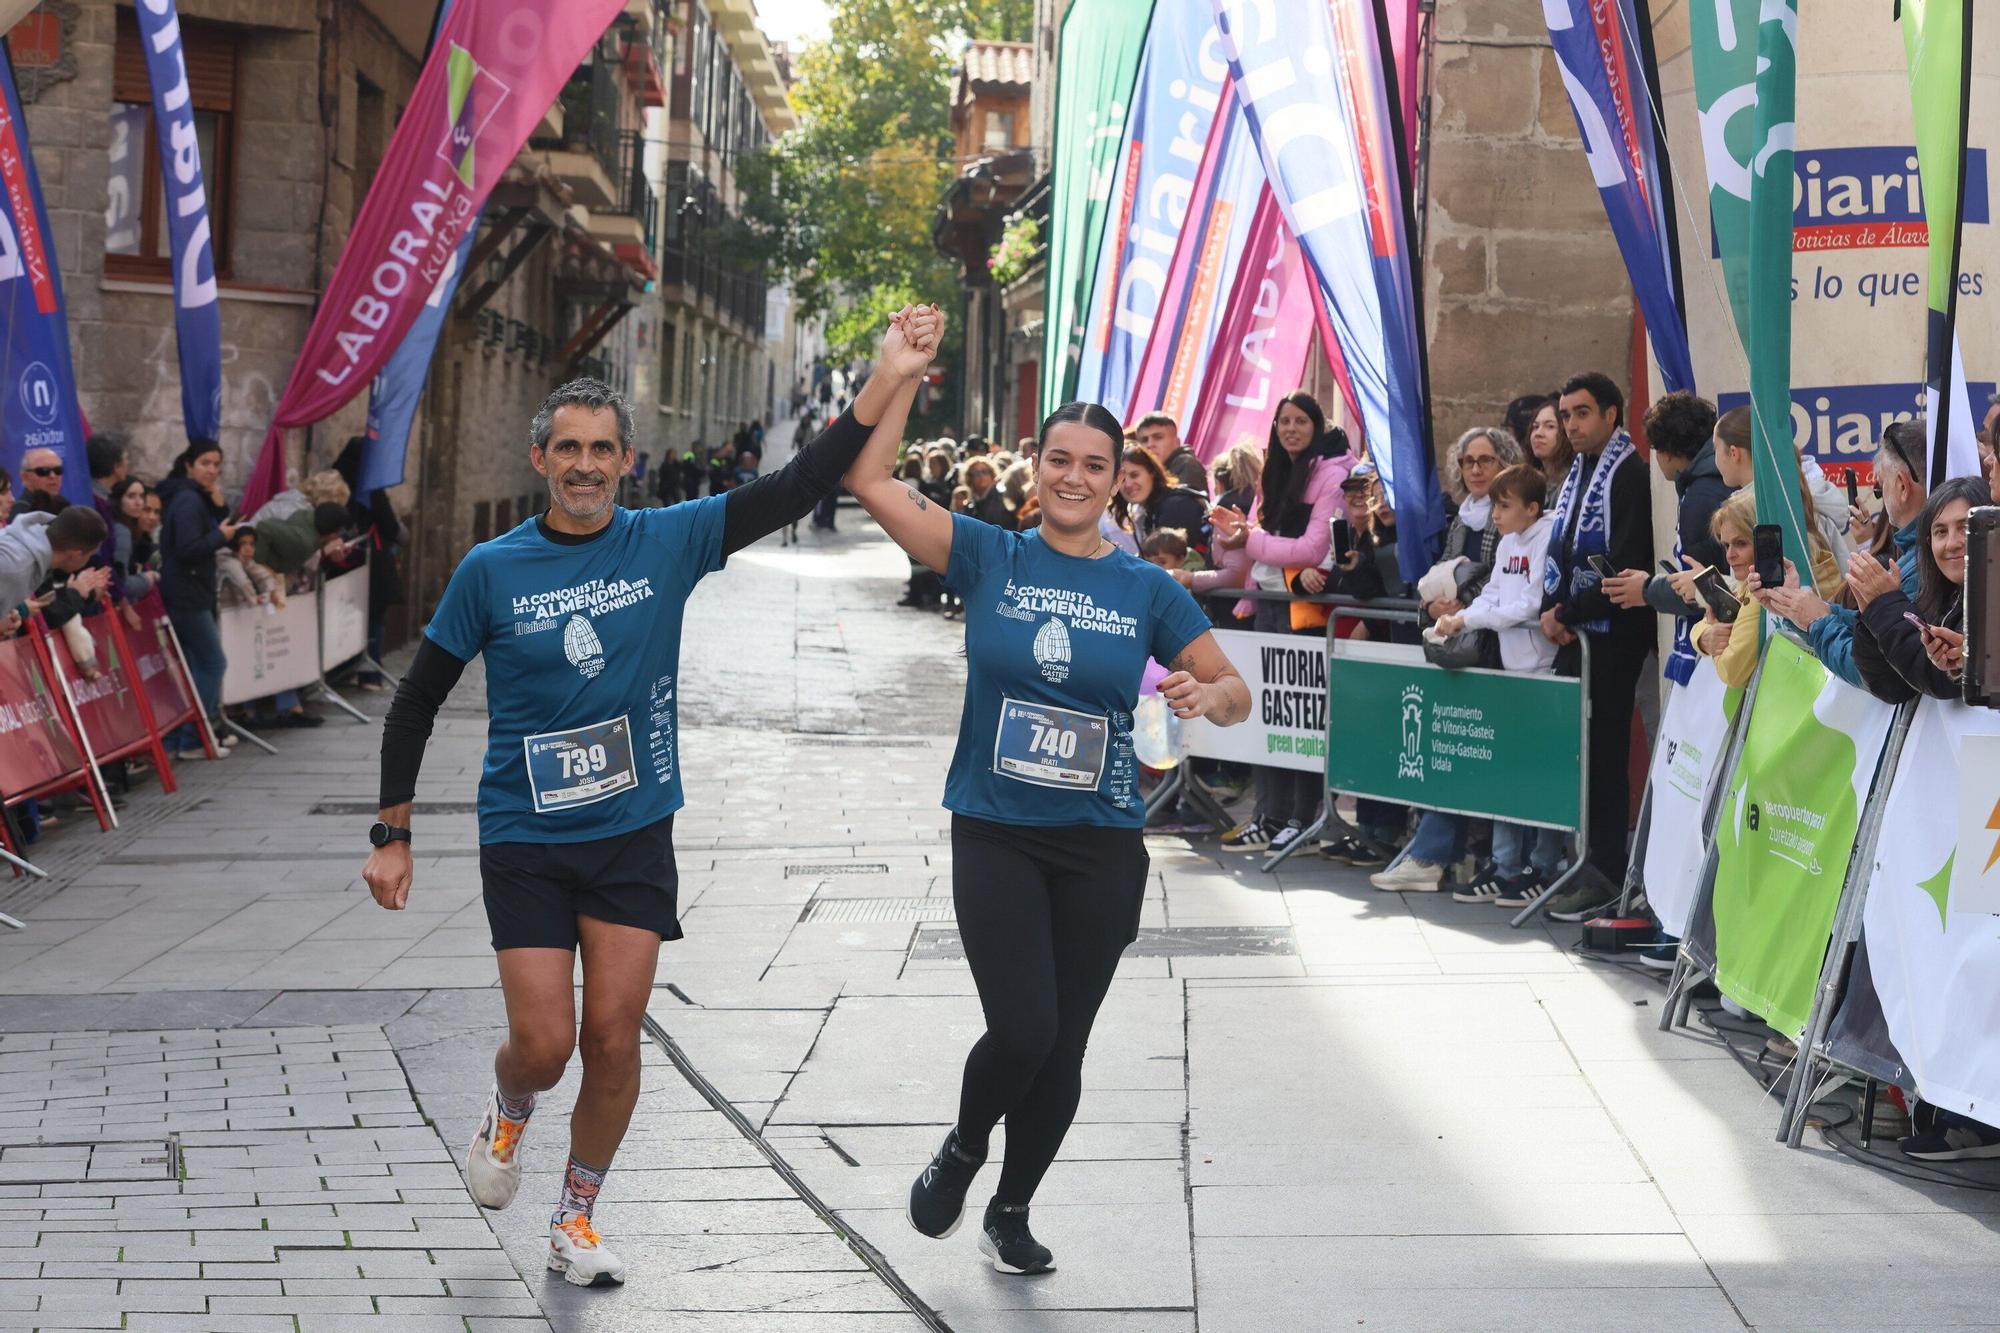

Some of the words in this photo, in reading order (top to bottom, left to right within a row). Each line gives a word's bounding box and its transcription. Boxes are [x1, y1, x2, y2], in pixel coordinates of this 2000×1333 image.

[420, 193, 473, 285] kutxa
[1857, 228, 1875, 245] de
[316, 179, 455, 385] LABORAL
[1814, 266, 1843, 299] lo
[1858, 272, 1920, 307] que
[513, 597, 529, 608] LA
[530, 579, 605, 605] CONQUISTA
[514, 607, 525, 615] DE
[526, 605, 536, 613] LA
[535, 580, 633, 619] ALMENDRA
[632, 577, 650, 590] REN
[590, 586, 654, 617] KONKISTA
[1018, 586, 1093, 606] CONQUISTA
[1004, 588, 1013, 597] DE
[1017, 597, 1120, 623] ALMENDRA
[1121, 617, 1137, 626] REN
[1071, 617, 1136, 638] KONKISTA
[578, 658, 605, 669] VITORIA
[1042, 663, 1069, 672] VITORIA
[1261, 647, 1326, 688] VITORIA
[1041, 669, 1069, 679] GASTEIZ
[1262, 688, 1326, 731] GASTEIZ
[1432, 702, 1483, 721] Ayuntamiento
[613, 724, 623, 733] 5K
[1090, 722, 1101, 730] 5K
[1432, 720, 1441, 732] de
[1442, 721, 1495, 739] Vitoria-Gasteiz
[1029, 724, 1077, 759] 740
[1267, 733, 1293, 754] green
[1295, 734, 1326, 757] capita
[1432, 740, 1492, 760] Vitoria-Gasteizko
[556, 744, 607, 779] 739
[1041, 758, 1058, 766] IRATI
[1431, 758, 1451, 772] Udala
[579, 776, 596, 785] JOSU
